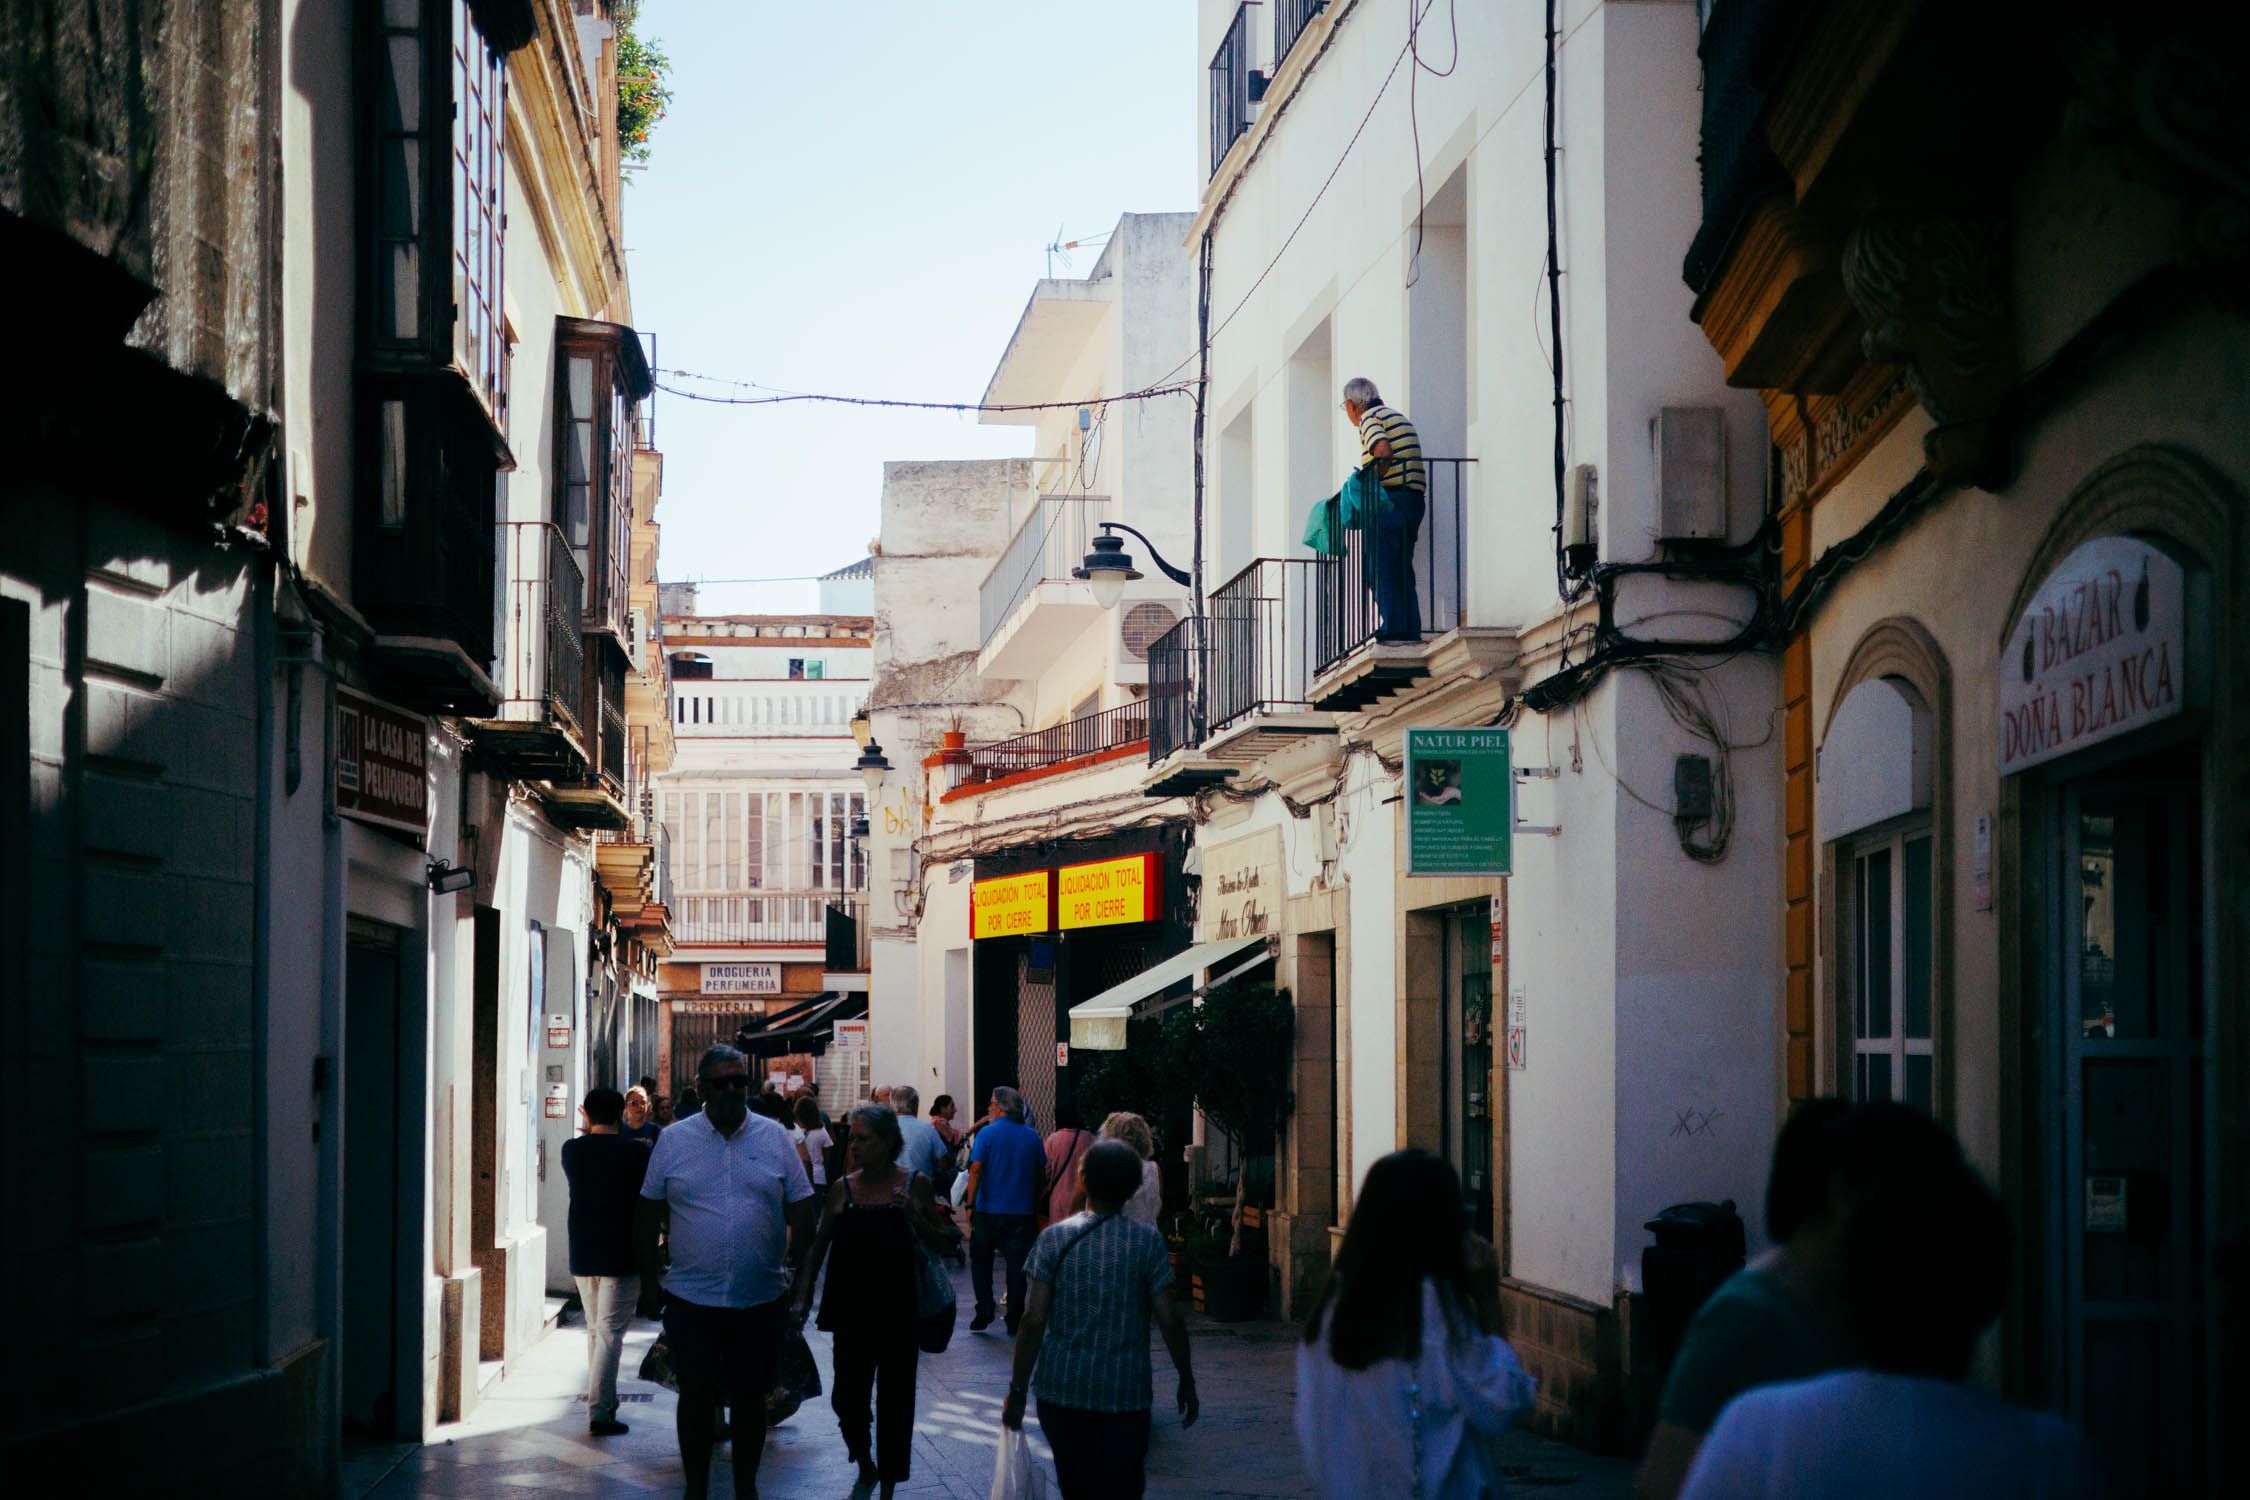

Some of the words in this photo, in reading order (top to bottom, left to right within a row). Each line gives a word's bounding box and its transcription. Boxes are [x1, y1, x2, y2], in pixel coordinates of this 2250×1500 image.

[2043, 569, 2123, 673] BAZAR
[2004, 683, 2063, 764] DOÑA
[2072, 642, 2176, 739] BLANCA
[364, 716, 376, 751] LA
[381, 721, 403, 761] CASA
[407, 730, 423, 768] DEL
[1414, 735, 1467, 748] NATUR
[1471, 735, 1505, 748] PIEL
[364, 760, 423, 810] PELUQUERO
[1115, 867, 1142, 889] TOTAL
[1024, 883, 1046, 901] TOTAL
[988, 914, 1002, 931] POR
[1006, 910, 1033, 929] CIERRE
[1074, 902, 1091, 921] POR
[1096, 898, 1126, 919] CIERRE
[705, 981, 776, 990] PERFUMERIA
